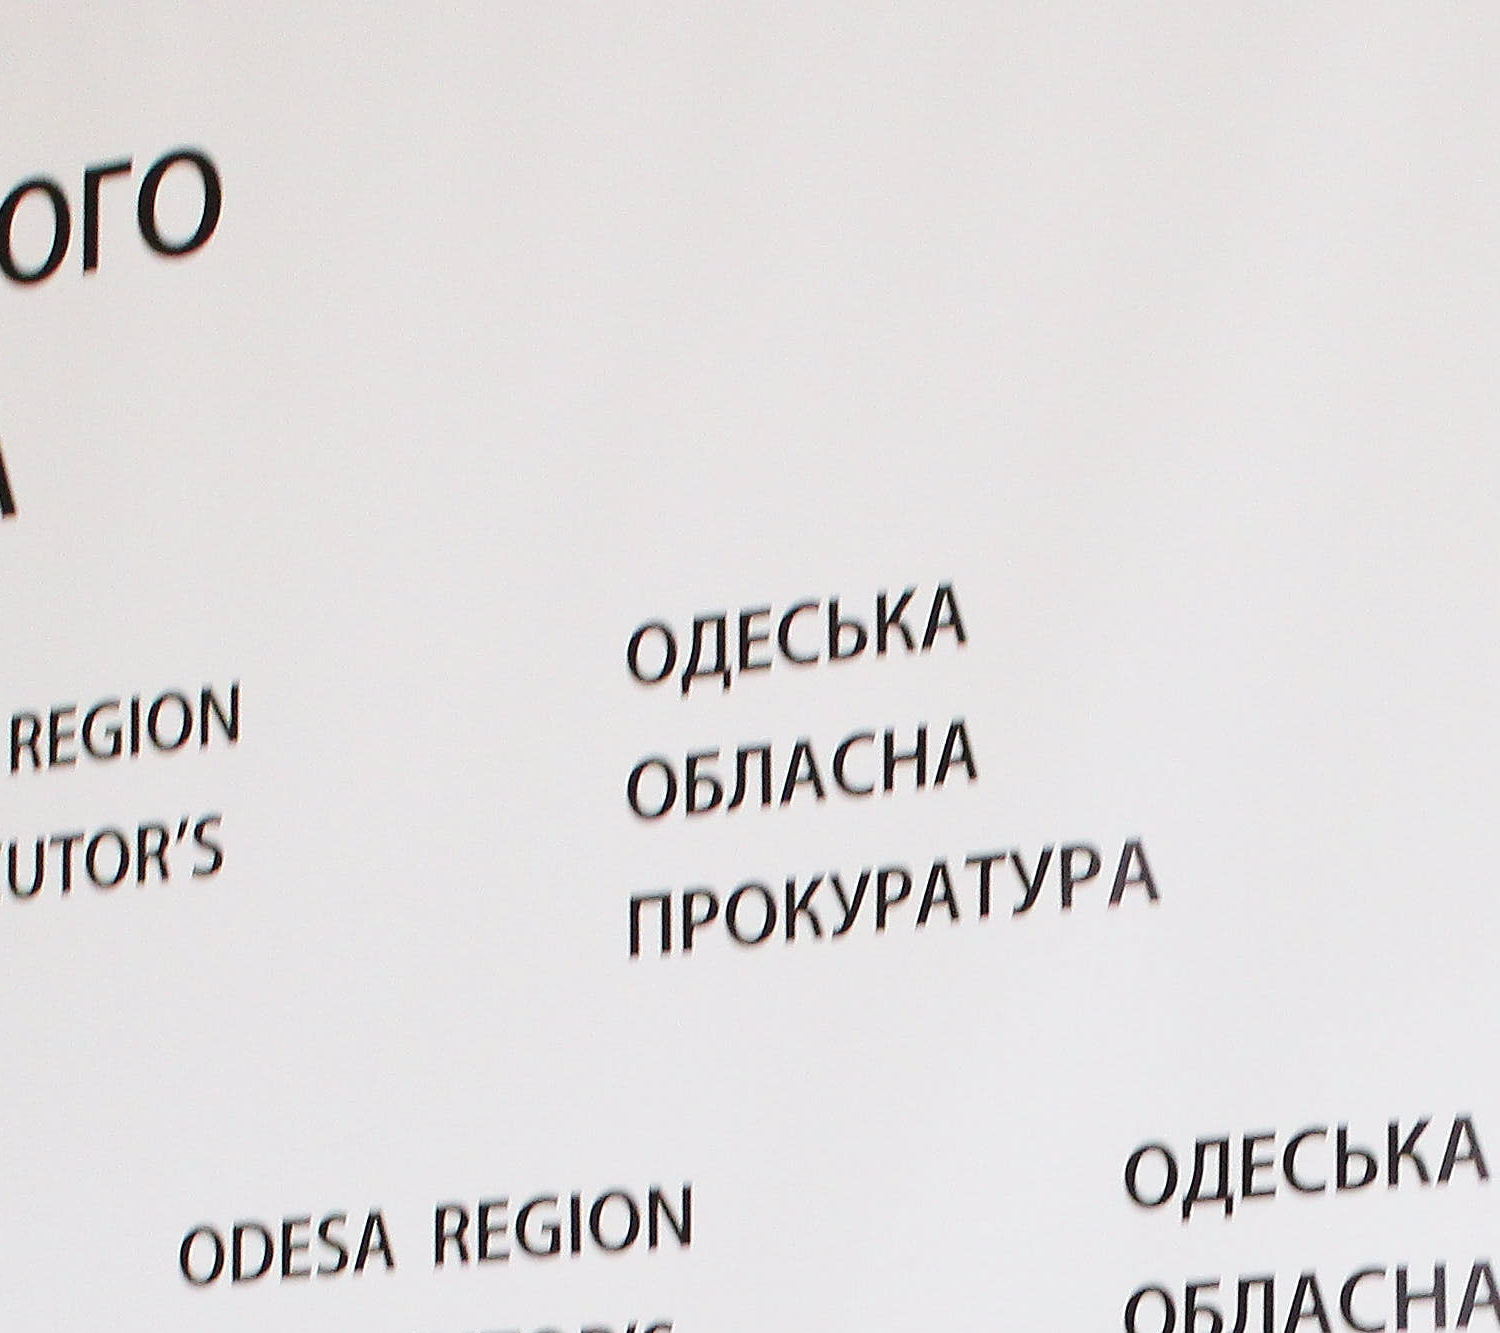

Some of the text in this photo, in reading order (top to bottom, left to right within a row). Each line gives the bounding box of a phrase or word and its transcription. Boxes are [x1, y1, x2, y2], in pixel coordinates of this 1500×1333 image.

[625, 583, 968, 697] ОДЕСЬКА
[9, 682, 241, 775] REGION
[625, 718, 979, 822] ОБЛАСНА
[628, 839, 1161, 959] ПРОКУРАТУРА
[1123, 1115, 1491, 1223] ОДЕСЬКА
[178, 1184, 693, 1288] ODESA REGION
